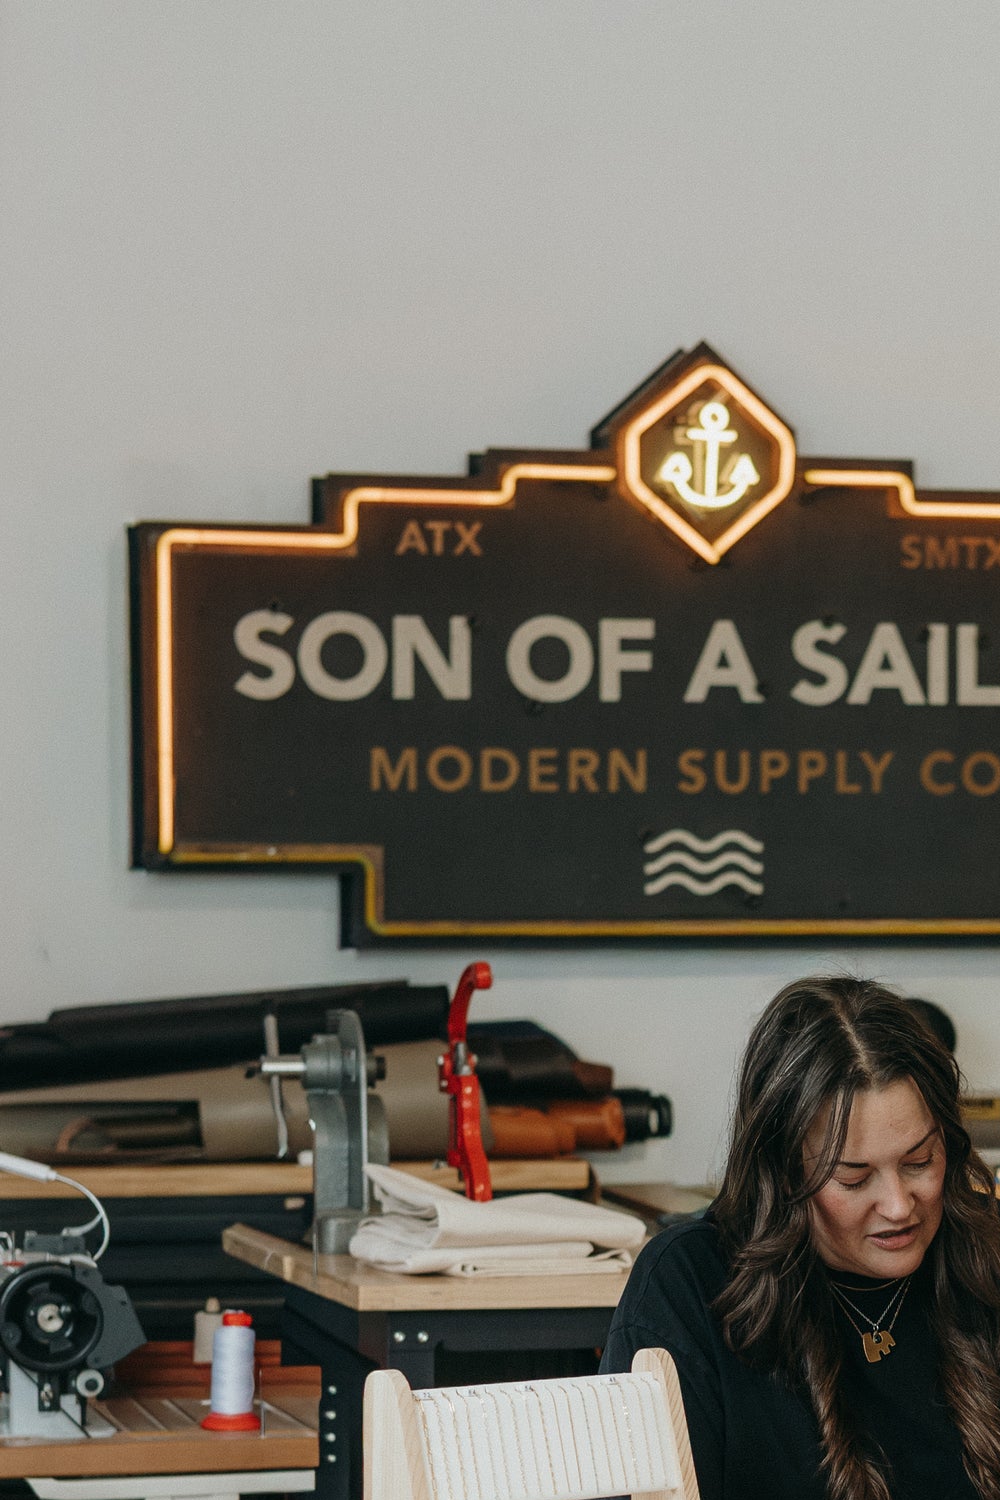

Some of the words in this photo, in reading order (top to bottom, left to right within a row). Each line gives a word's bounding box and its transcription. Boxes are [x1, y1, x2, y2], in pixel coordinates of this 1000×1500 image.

[396, 520, 484, 556] ATX
[233, 609, 473, 701] SON
[505, 614, 656, 704] OF
[684, 619, 765, 704] A
[369, 746, 649, 793] MODERN
[677, 750, 895, 795] SUPPLY
